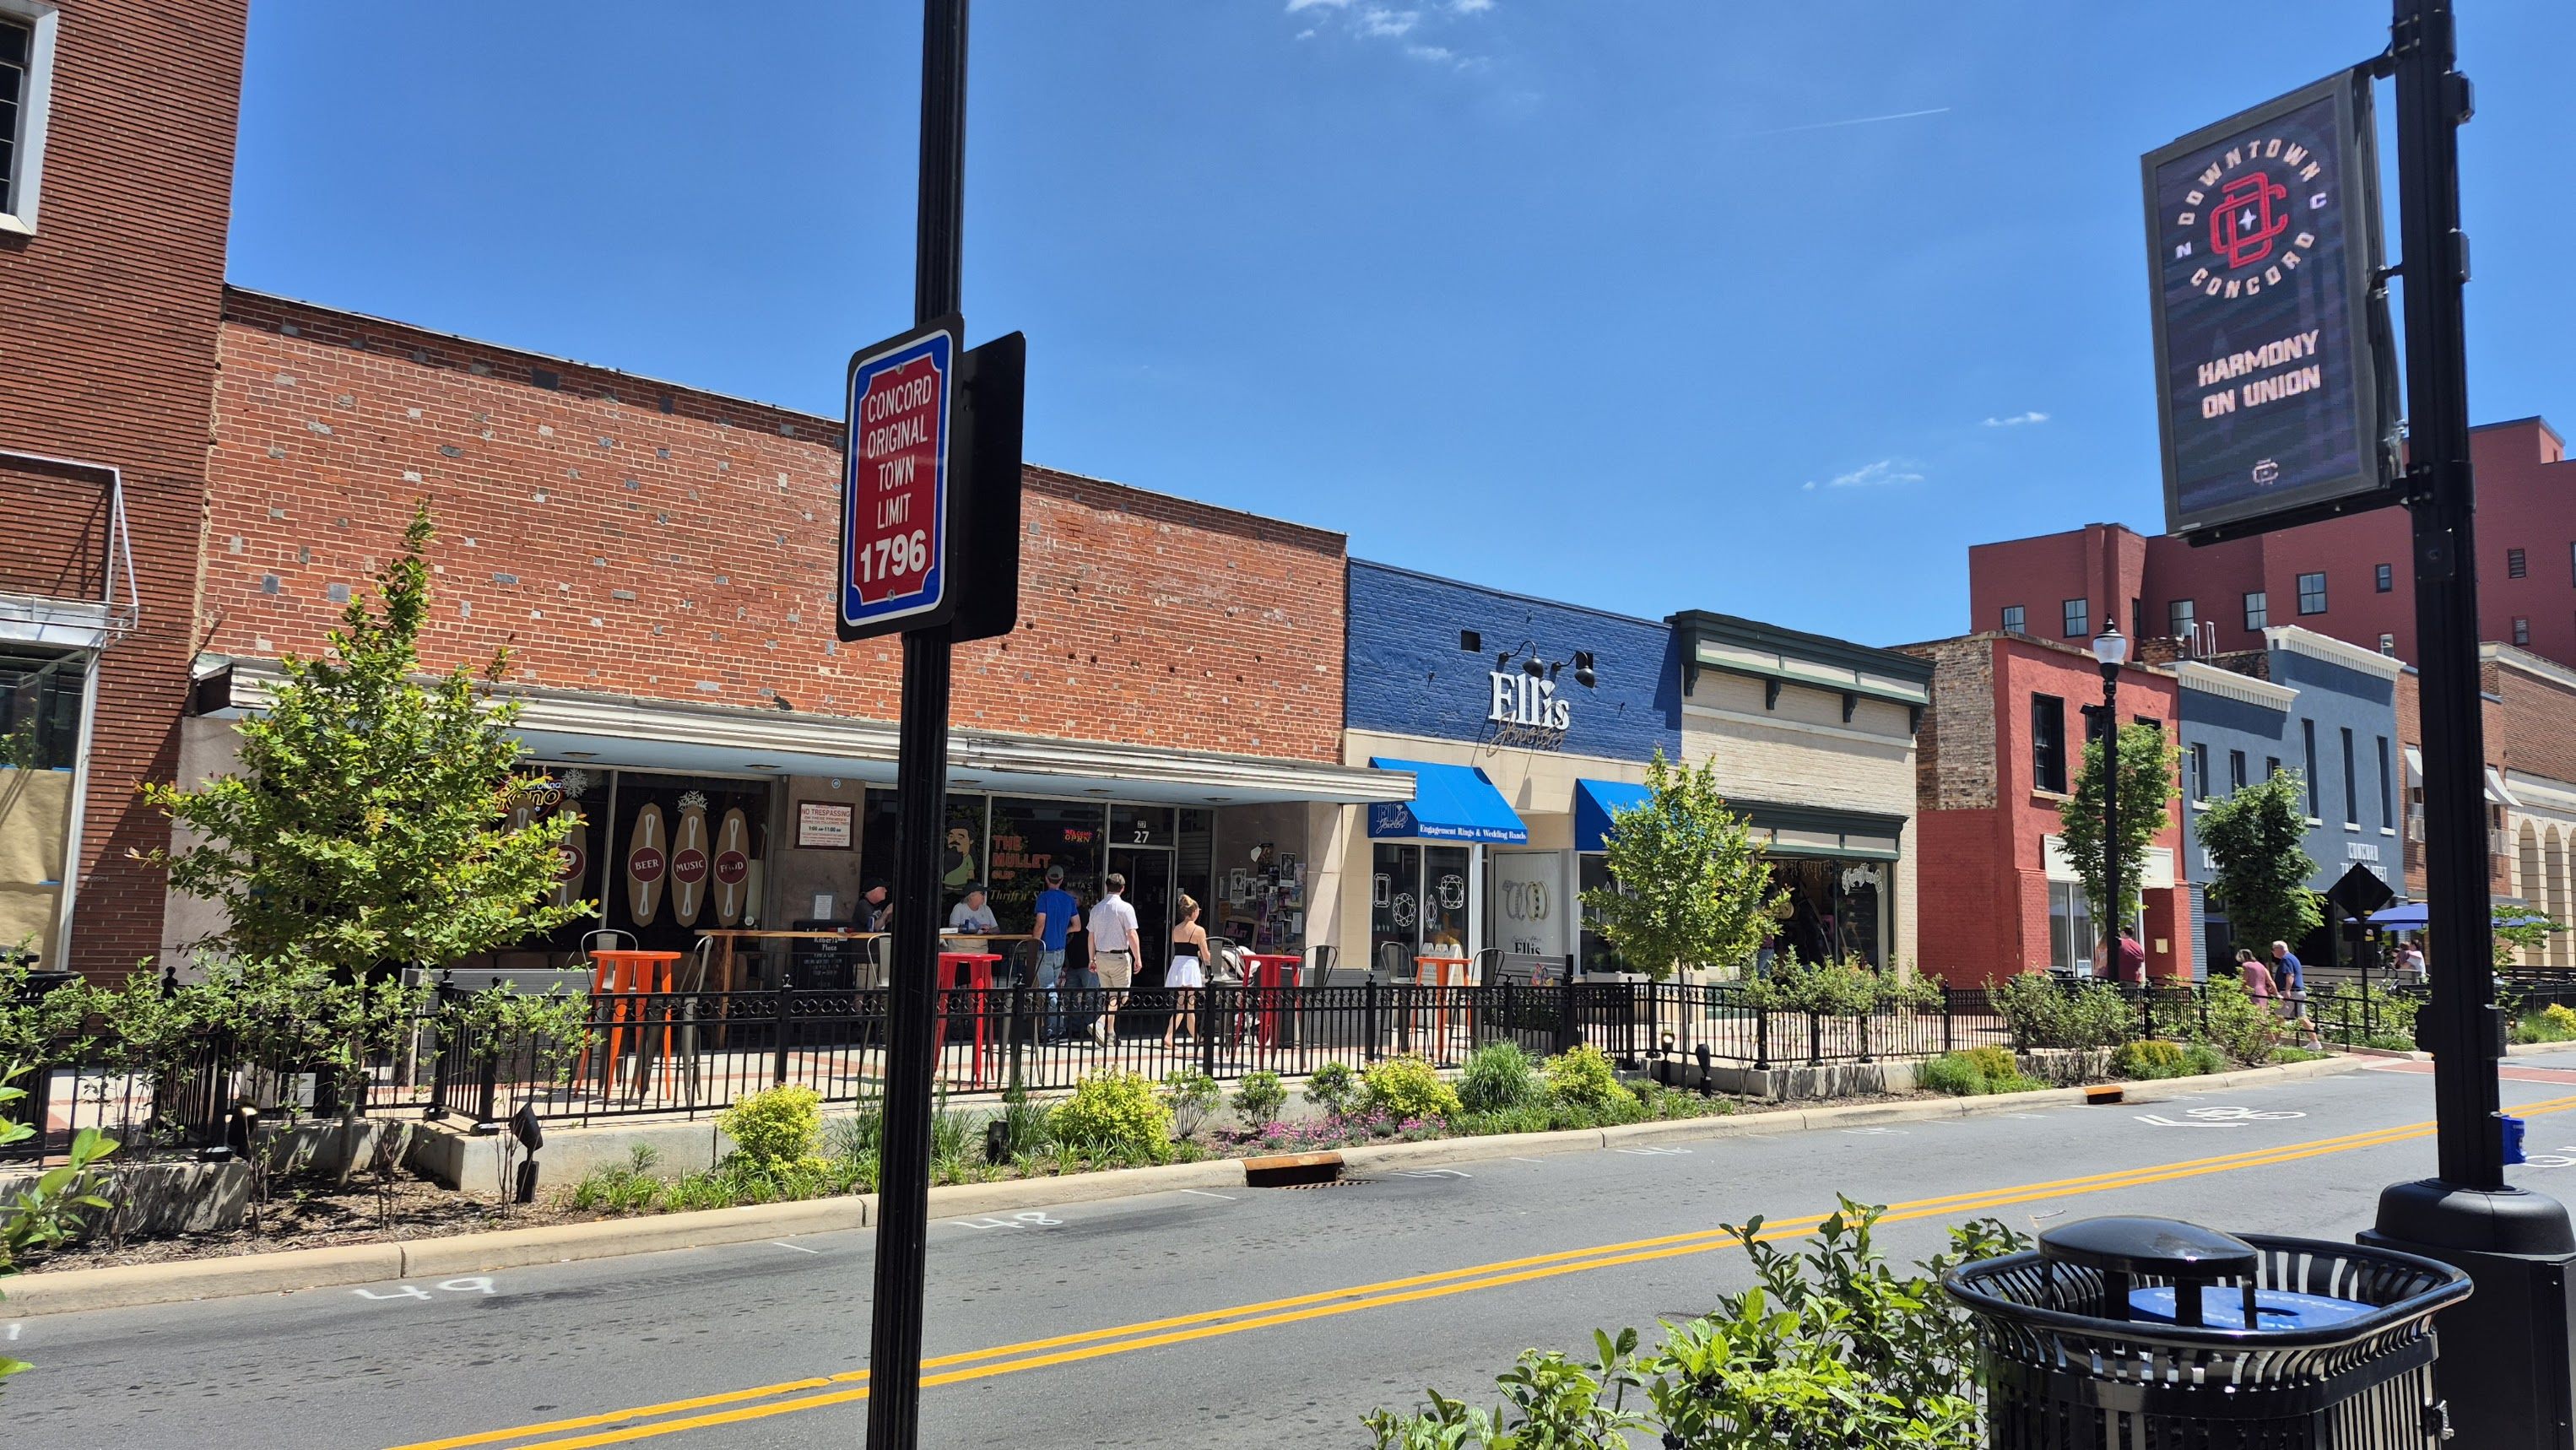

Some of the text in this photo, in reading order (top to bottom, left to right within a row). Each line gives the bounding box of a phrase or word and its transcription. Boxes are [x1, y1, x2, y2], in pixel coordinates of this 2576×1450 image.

[2177, 138, 2321, 225] DOWNTOWN
[2190, 231, 2315, 299] CONCORD
[2198, 329, 2319, 387] HARMONY
[868, 375, 932, 424] CONCORD
[2202, 364, 2321, 419] ON UNION
[867, 414, 928, 460] ORIGINAL
[878, 454, 914, 493] TOWN
[877, 493, 912, 529] LIMIT
[860, 529, 927, 583] 1796
[1488, 671, 1570, 730] Ellis
[1486, 701, 1566, 758] Jewelers
[812, 809, 850, 817] TRESPASSING
[1377, 803, 1409, 822] Ellis
[993, 835, 1022, 852] THE
[1134, 831, 1150, 843] 27
[1420, 824, 1527, 841] Engagement Rings & Wedding Bands
[992, 852, 1053, 869] MULLET
[2346, 842, 2378, 862] CONCORD
[635, 859, 659, 870] BEER
[676, 859, 704, 873] MUSIC
[720, 862, 744, 874] FOOD
[1514, 942, 1540, 955] Ellis
[950, 1212, 1063, 1229] 48
[350, 1277, 498, 1301] 49
